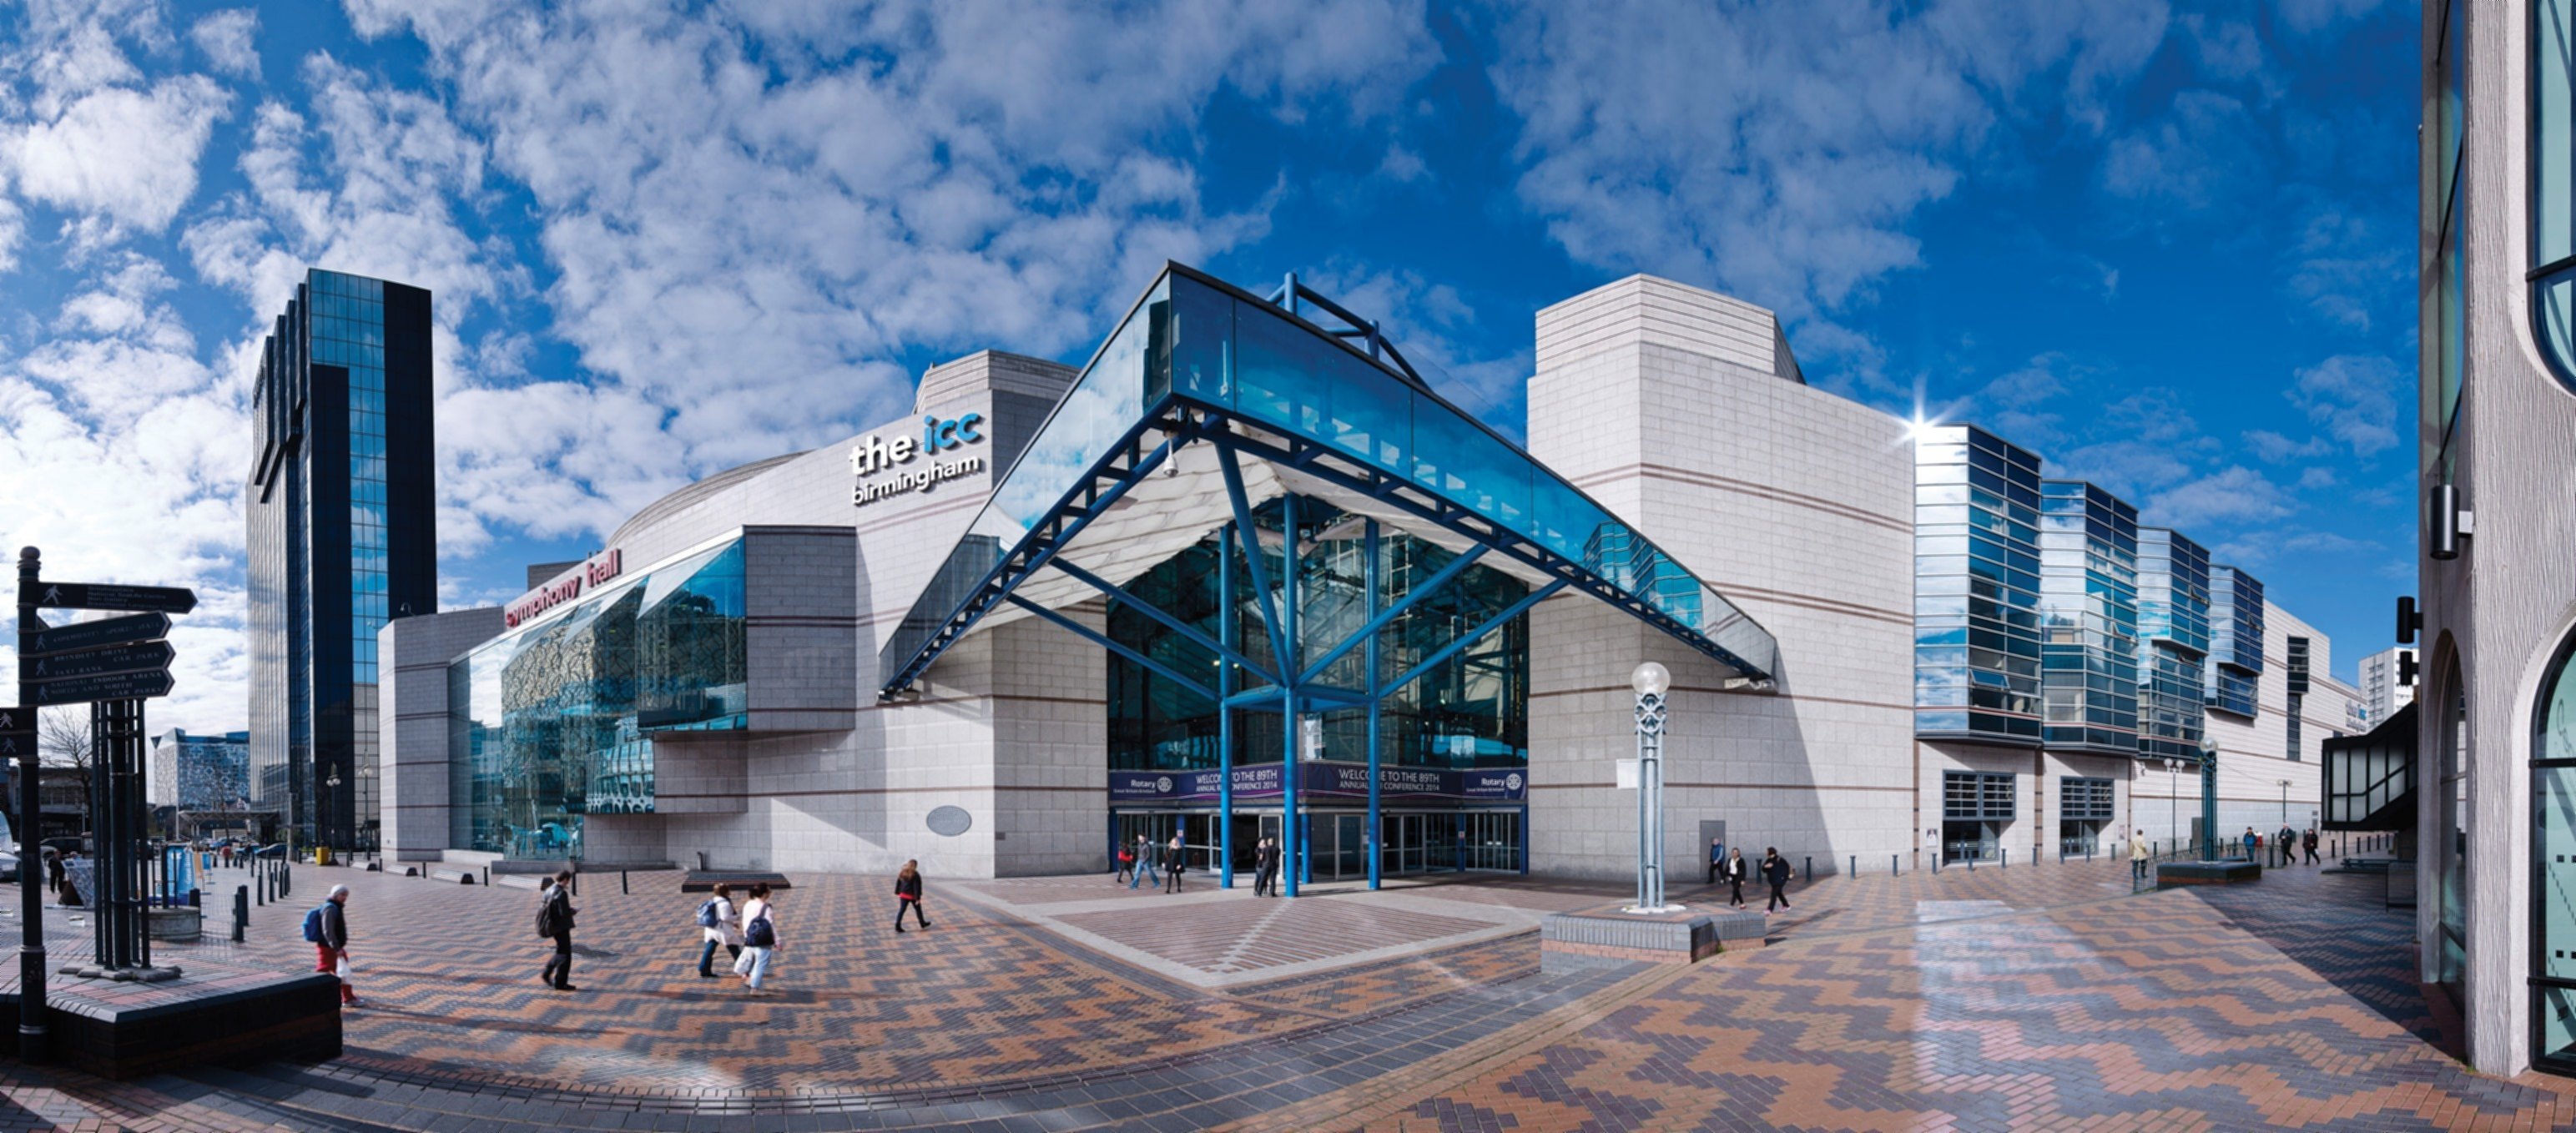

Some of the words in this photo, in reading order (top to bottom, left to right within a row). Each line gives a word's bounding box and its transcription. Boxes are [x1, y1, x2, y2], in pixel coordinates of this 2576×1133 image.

[849, 434, 913, 475] the
[924, 412, 980, 453] icc
[852, 456, 979, 505] birmingham
[506, 576, 581, 627] symphony
[586, 548, 621, 587] hall
[1196, 773, 1222, 784] WELCO
[1241, 770, 1255, 781] THE
[1256, 768, 1278, 781] 89TH
[1388, 771, 1400, 782] TO
[1401, 772, 1418, 783] THE
[1419, 773, 1439, 783] 89TH
[1131, 779, 1156, 788] Rotary
[1263, 781, 1278, 789] 2014
[1383, 782, 1424, 791] CONFERENCE
[1481, 778, 1505, 787] Rotary
